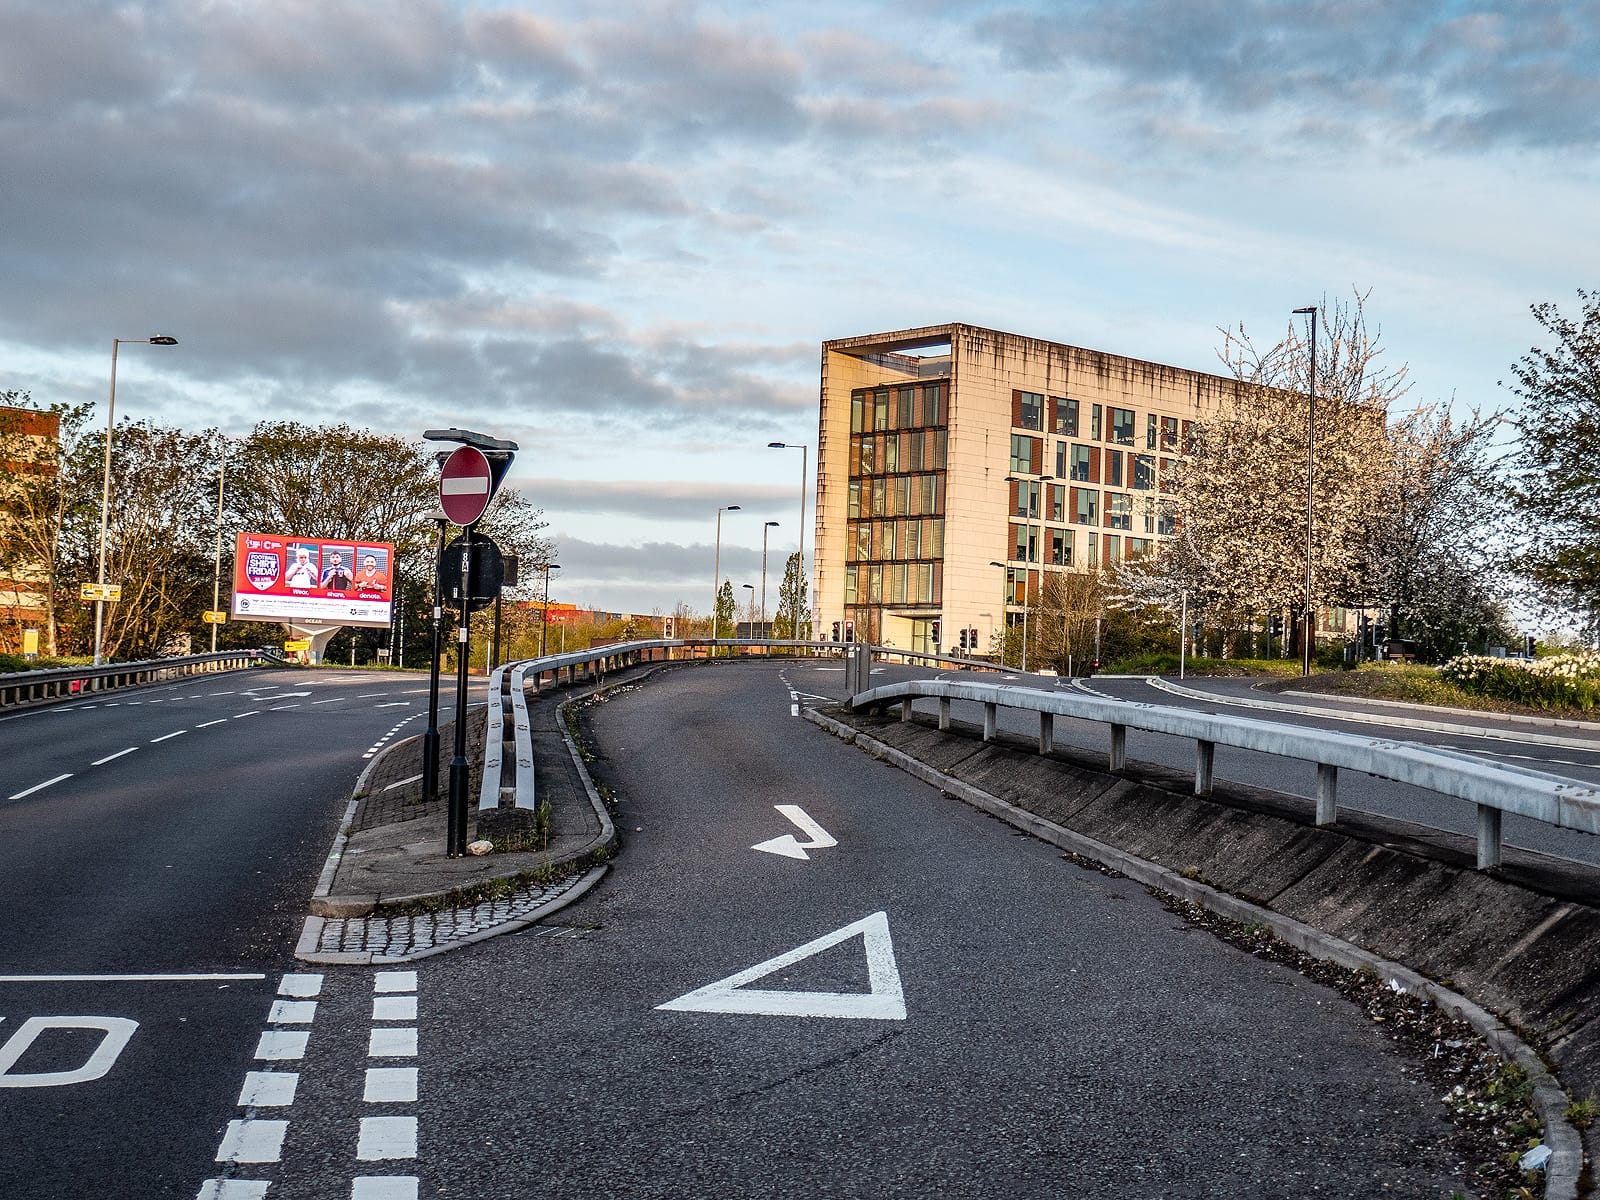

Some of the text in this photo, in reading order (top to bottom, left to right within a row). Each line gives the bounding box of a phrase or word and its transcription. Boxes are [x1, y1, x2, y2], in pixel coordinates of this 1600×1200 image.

[250, 560, 277, 568] SHIRT
[248, 567, 278, 577] FRIDAY
[359, 592, 381, 600] donate.
[0, 1015, 140, 1088] D
